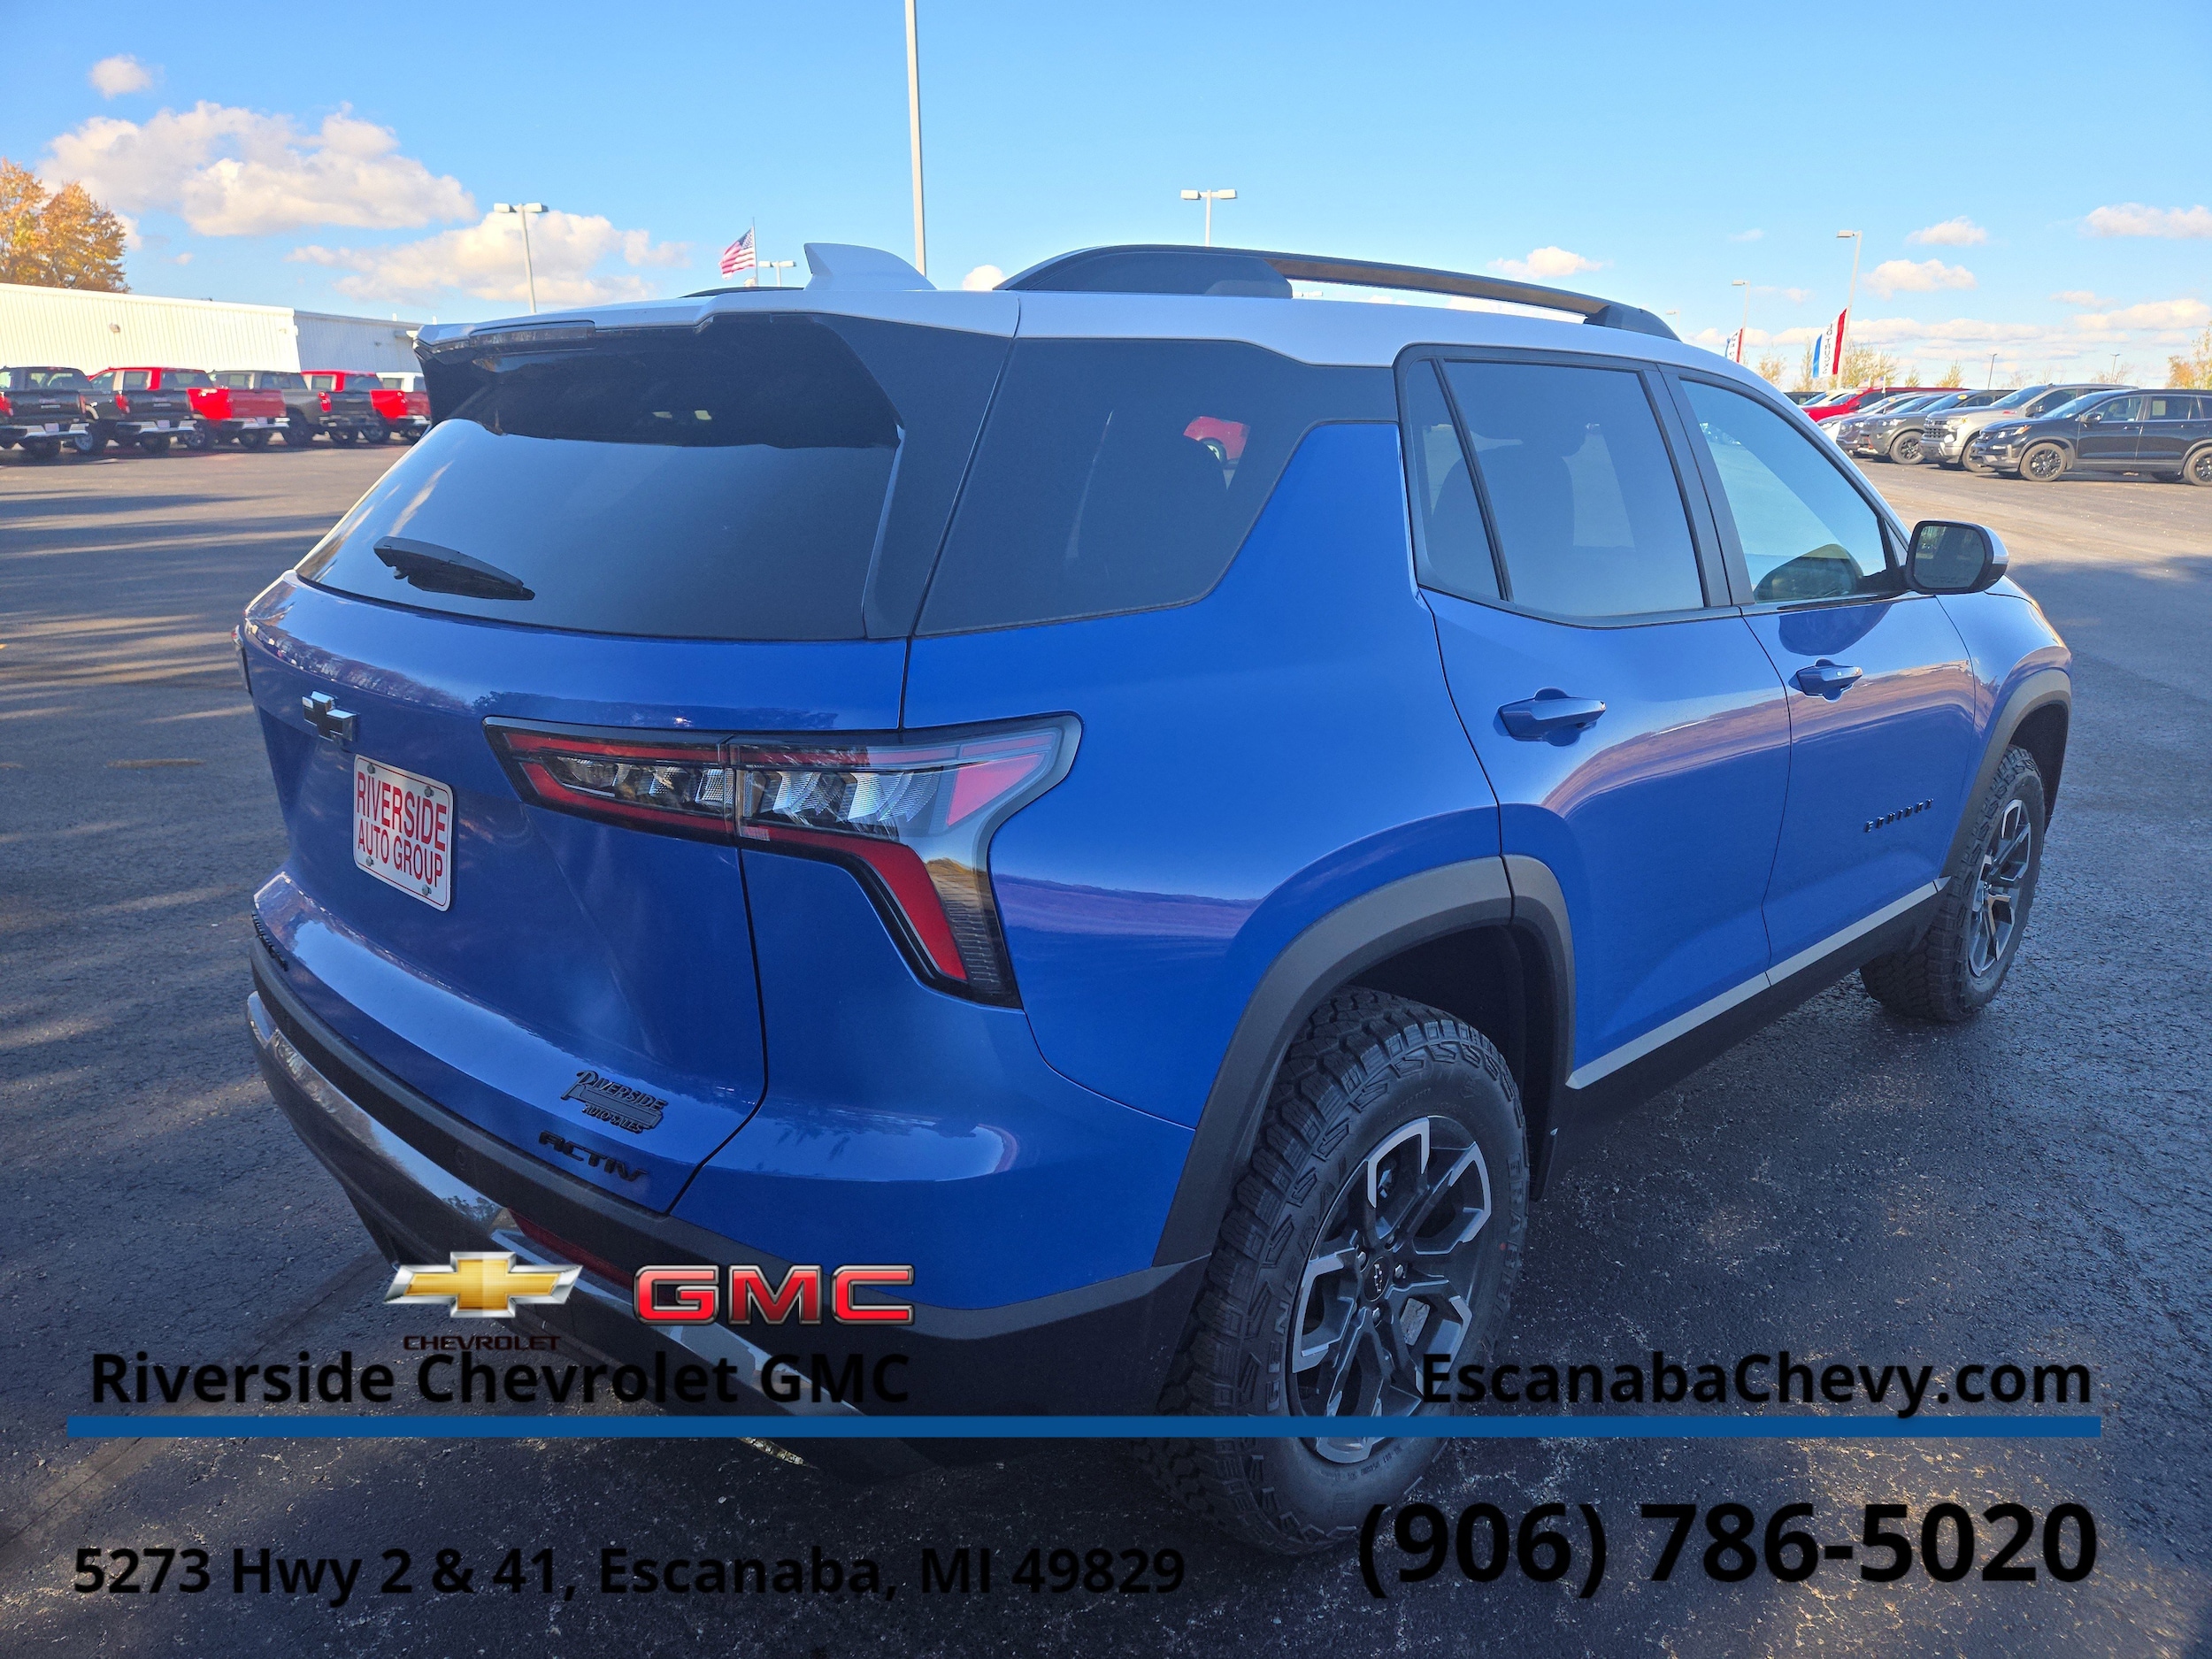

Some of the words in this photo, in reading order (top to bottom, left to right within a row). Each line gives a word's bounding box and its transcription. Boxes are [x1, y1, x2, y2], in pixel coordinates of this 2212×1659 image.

[357, 772, 447, 852] RIVERSIDE
[357, 819, 389, 864] AUTO
[393, 835, 443, 887] GROUP
[561, 1070, 669, 1112] RIVERSIDE
[539, 1130, 649, 1182] ACTIV
